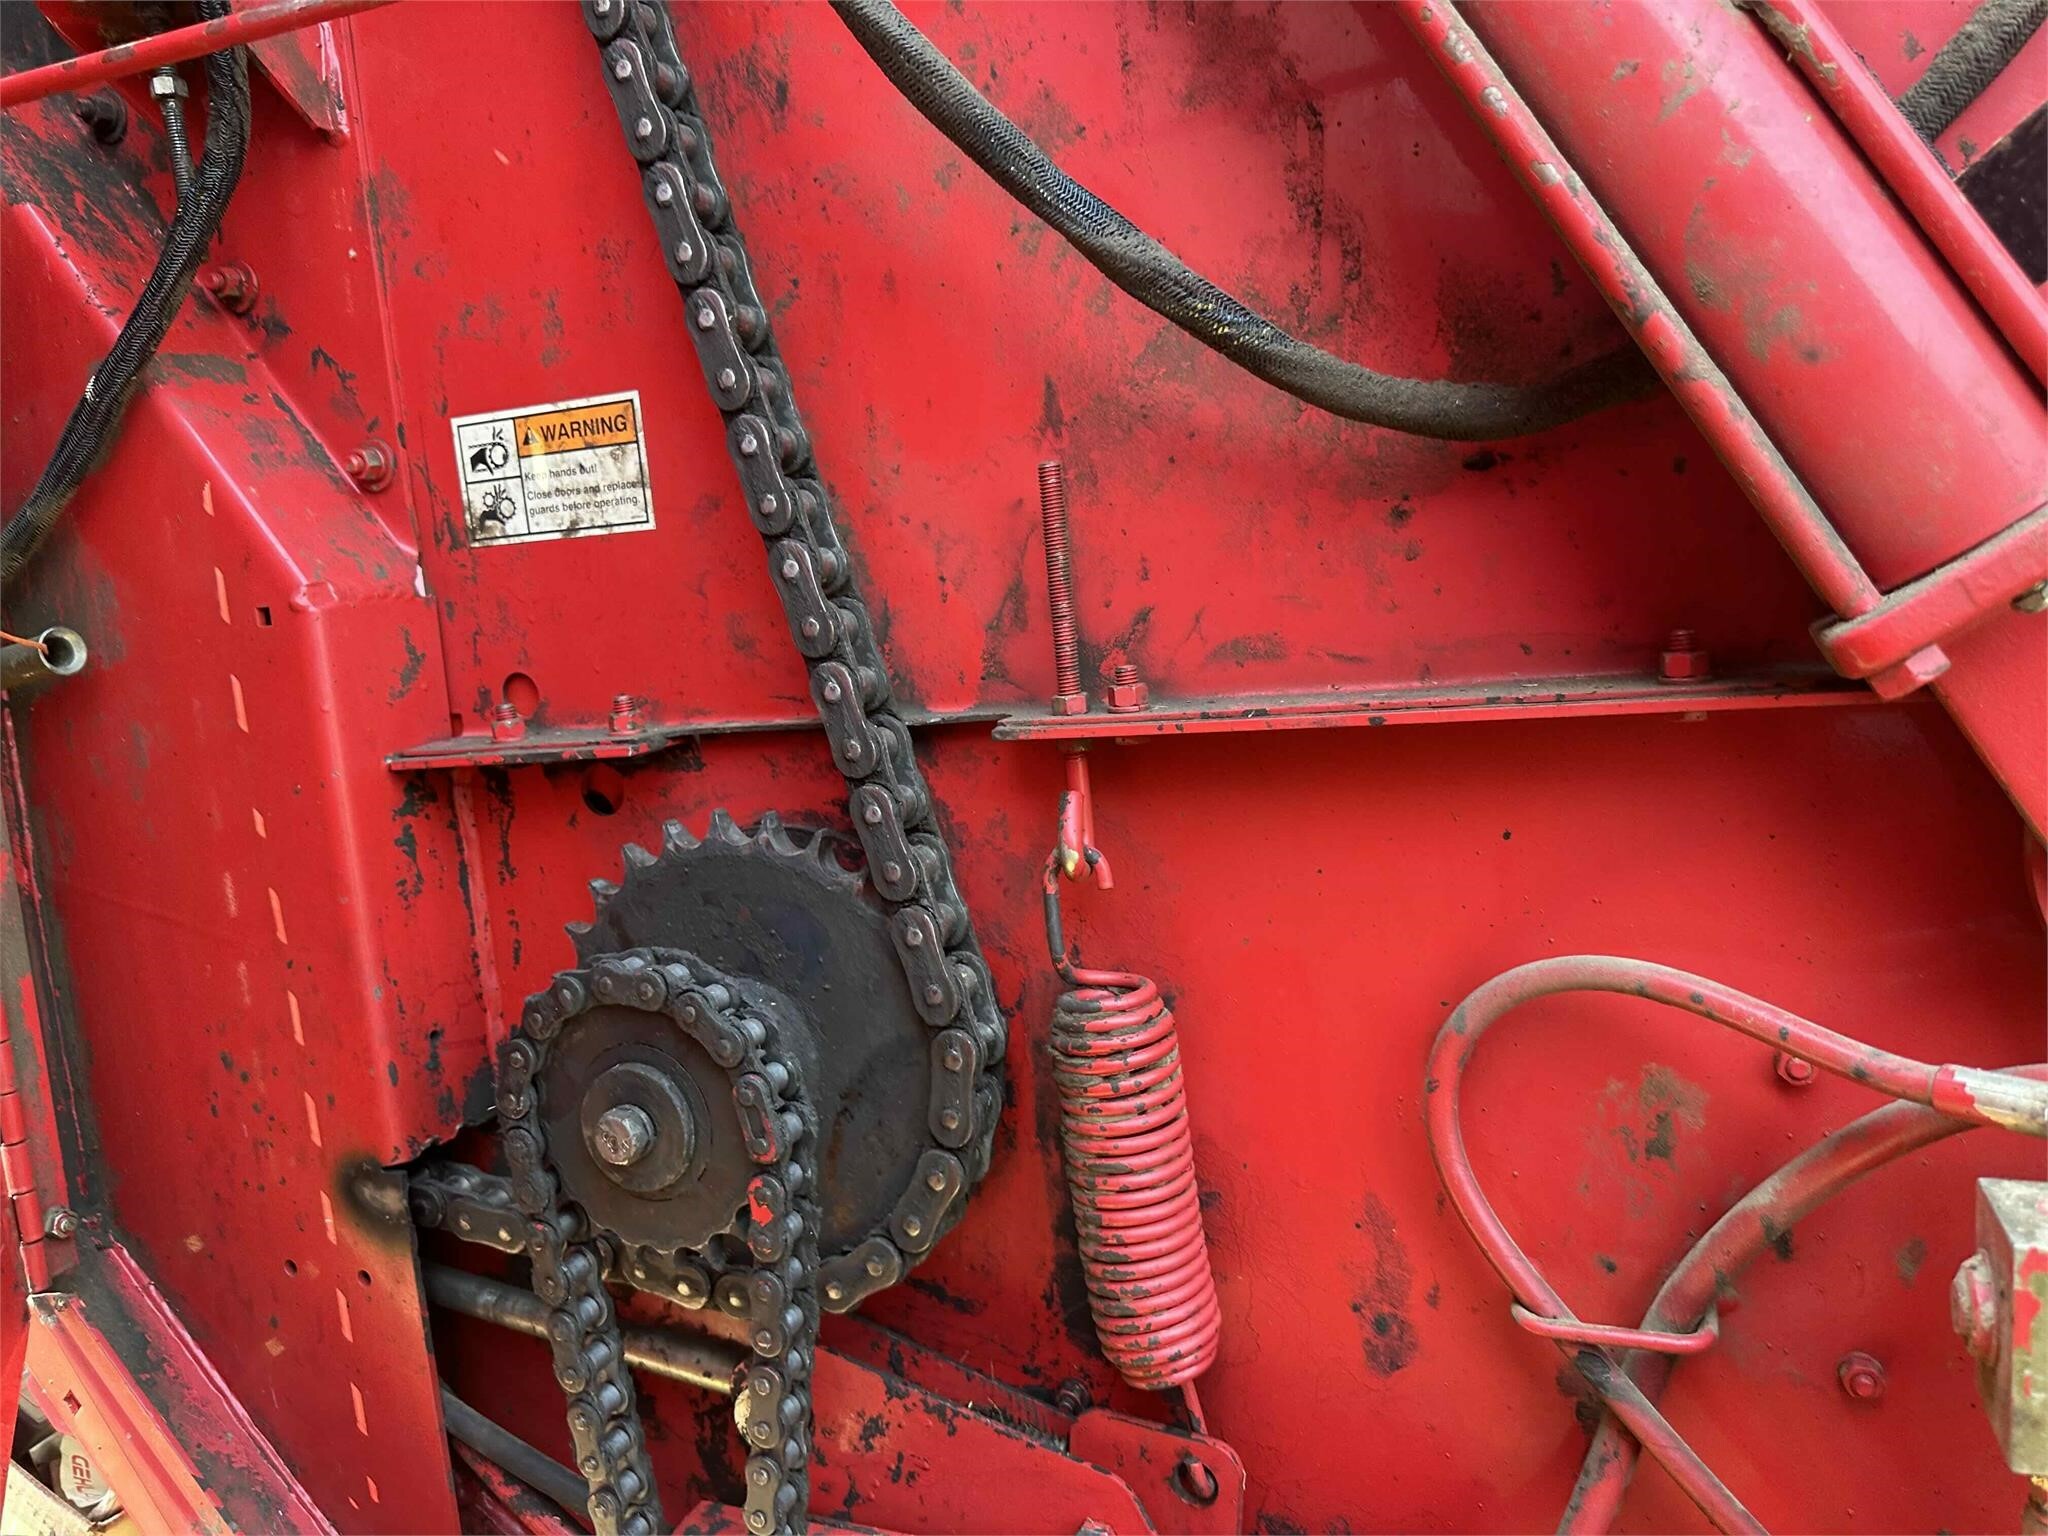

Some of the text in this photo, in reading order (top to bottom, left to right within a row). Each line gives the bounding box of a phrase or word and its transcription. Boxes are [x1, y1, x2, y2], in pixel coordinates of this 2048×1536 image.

[540, 414, 627, 442] WARNING
[549, 467, 577, 478] hands
[579, 464, 598, 474] out!
[527, 490, 553, 501] Close
[554, 486, 581, 496] doors
[583, 484, 601, 494] and
[529, 496, 641, 517] guards before operating.
